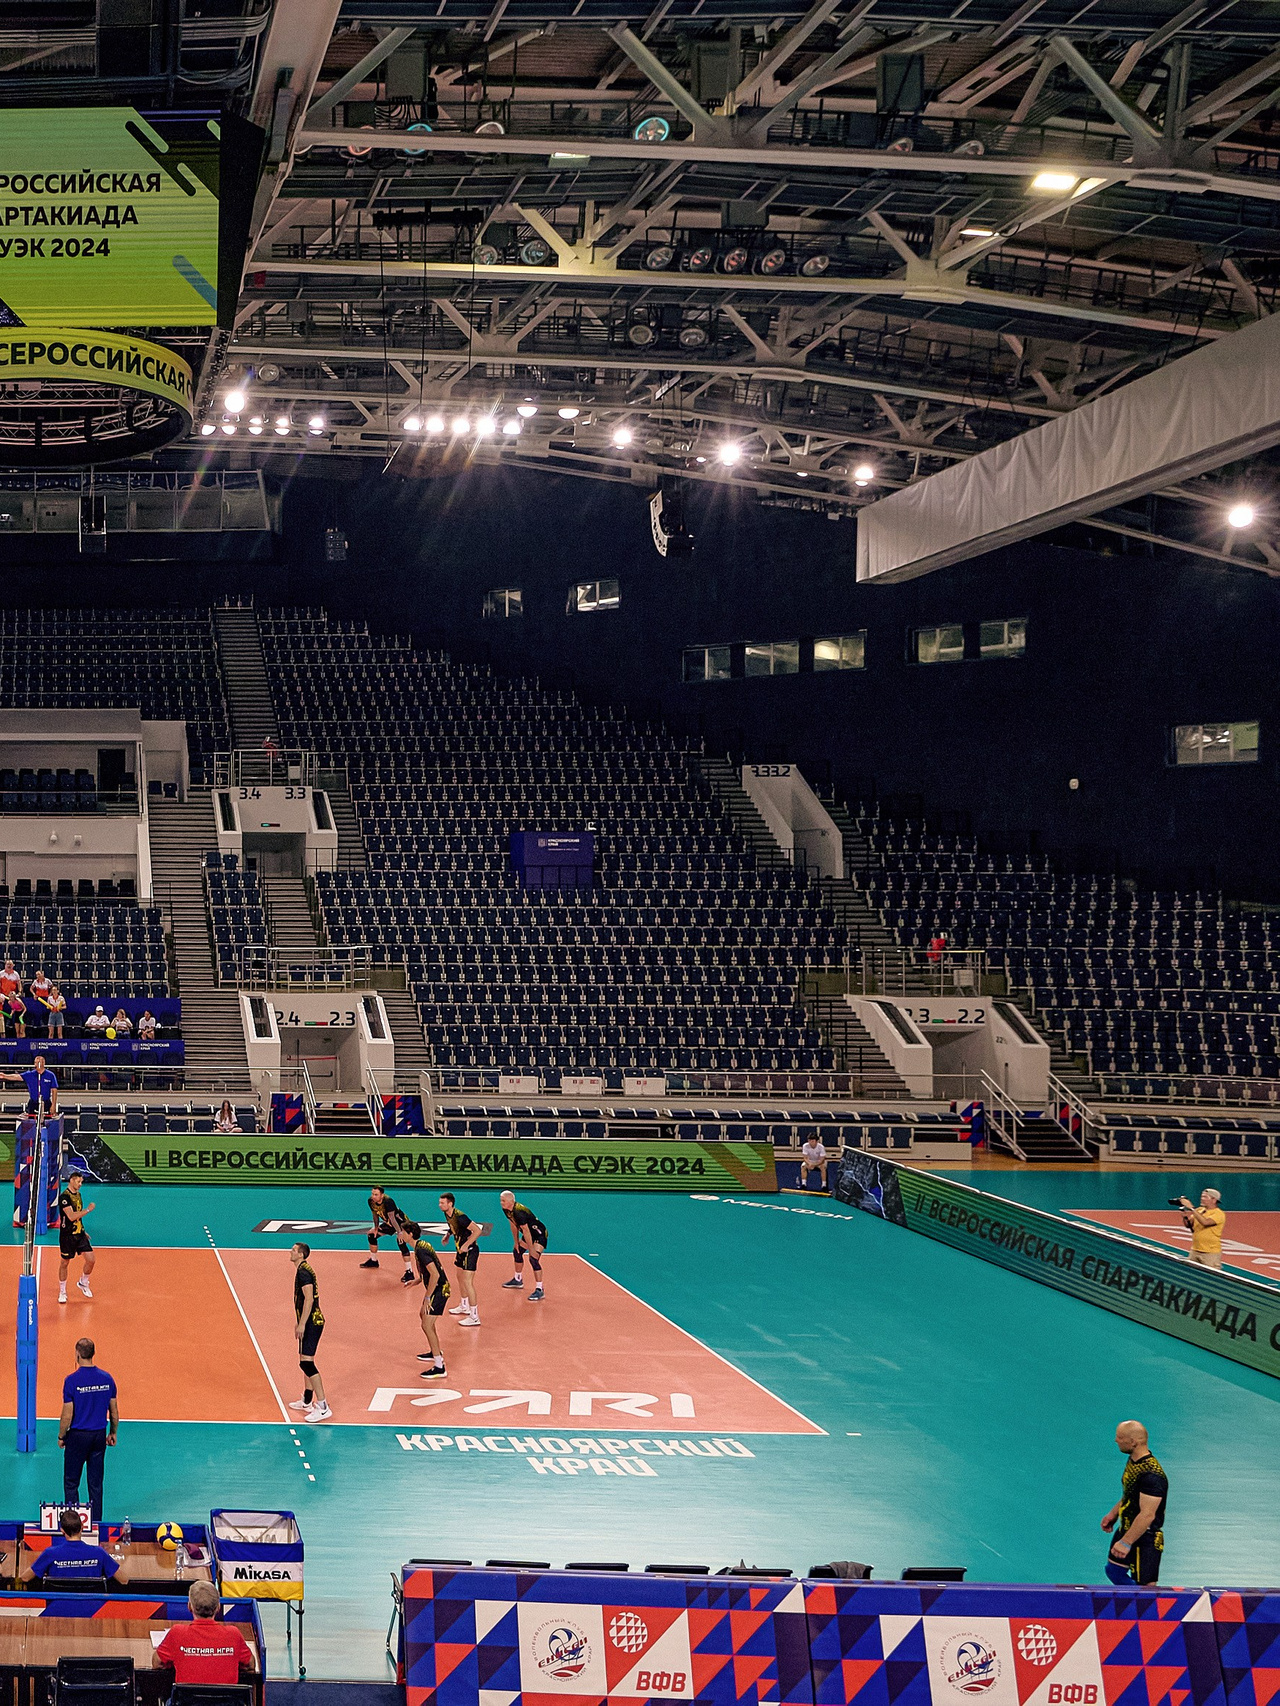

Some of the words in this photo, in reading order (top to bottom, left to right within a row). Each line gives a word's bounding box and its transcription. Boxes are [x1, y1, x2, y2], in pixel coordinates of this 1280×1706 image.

[50, 237, 111, 258] 2024
[239, 787, 261, 799] 3.4
[285, 787, 306, 799] 3.3
[275, 1011, 300, 1026] 2.4
[330, 1011, 356, 1026] 2.3
[957, 1009, 985, 1024] 2.2
[168, 1147, 372, 1171] ВСЕРОССИЙСКАЯ
[382, 1151, 564, 1176] СПАРТАКИАДА
[574, 1155, 635, 1175] СУЭК
[645, 1157, 706, 1176] 2024
[722, 1198, 853, 1220] МЕГАФОН
[928, 1196, 1075, 1272] ВСЕРОССИЙСКАЯ
[1081, 1255, 1257, 1342] СПАРТАКИАДА
[367, 1387, 696, 1418] PARI
[395, 1434, 756, 1458] КРАСНОЯРСКИЙ
[526, 1454, 659, 1477] КРАЙ
[45, 1512, 53, 1529] 1
[79, 1512, 89, 1529] 2
[233, 1564, 291, 1580] MIKASA
[636, 1671, 687, 1692] ВФВ
[1047, 1683, 1098, 1704] ВФВ
